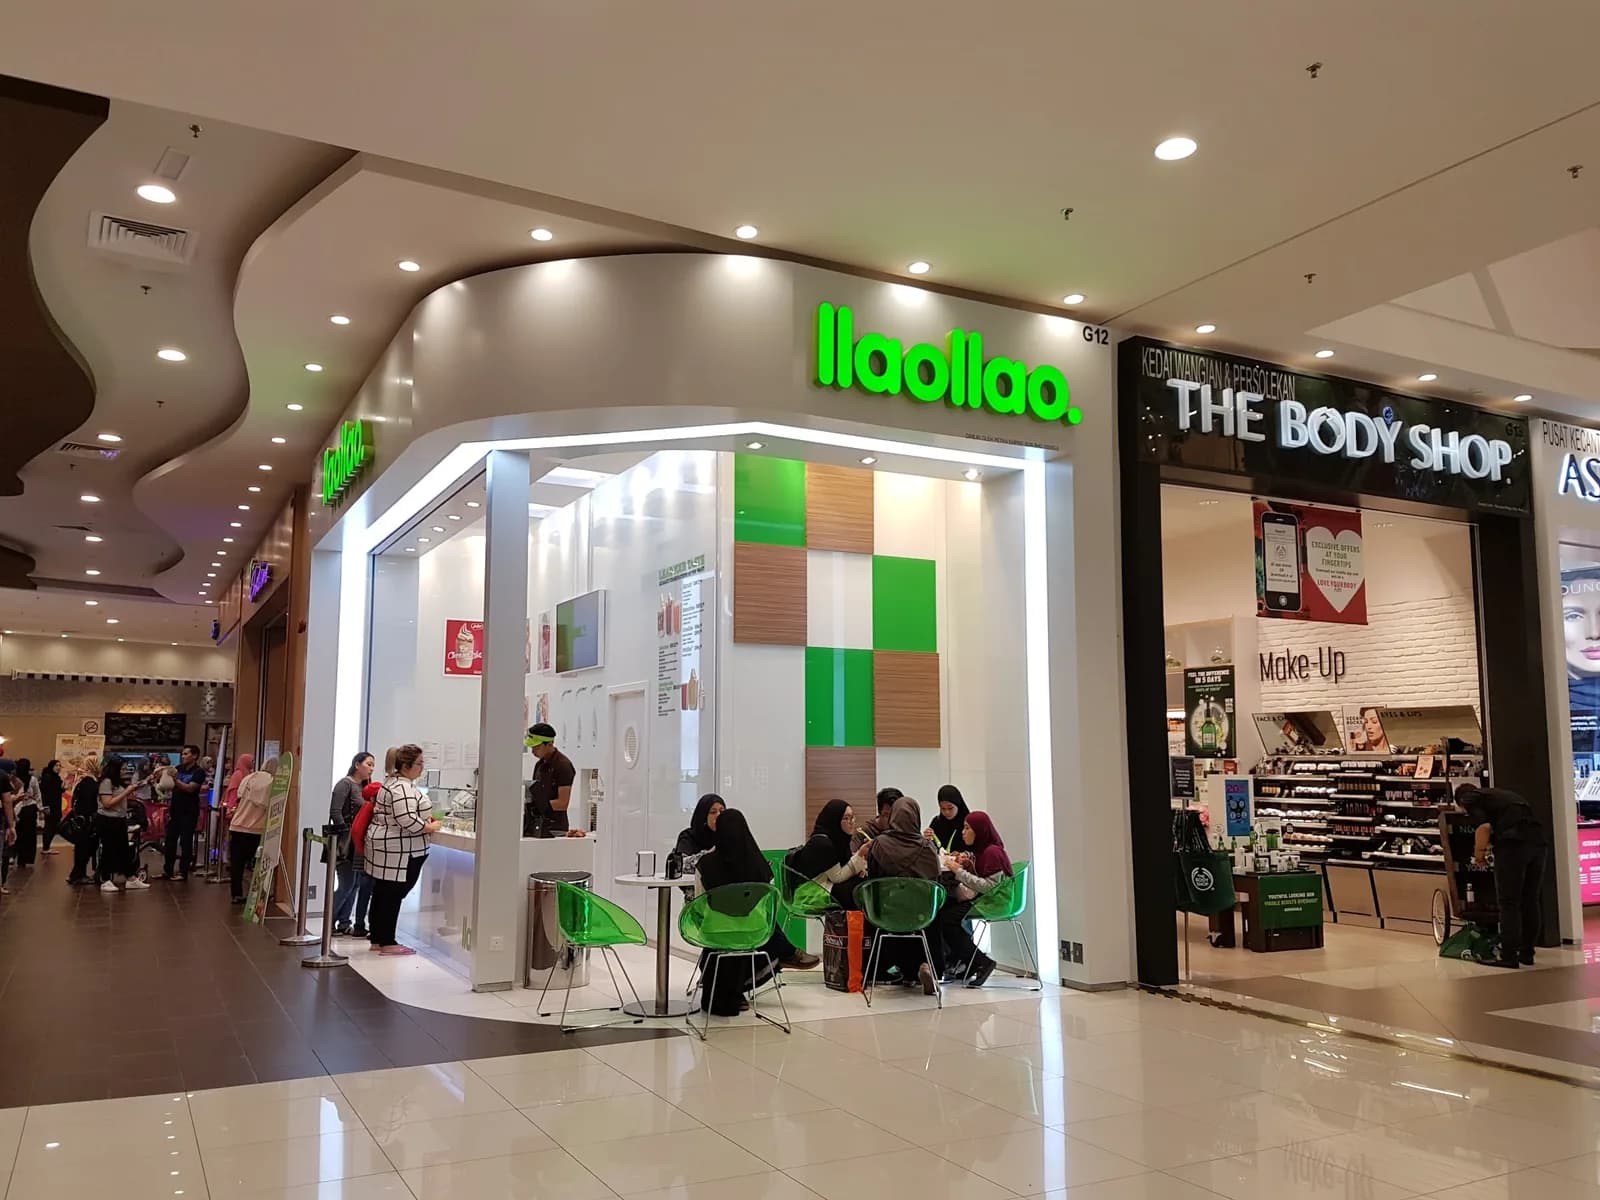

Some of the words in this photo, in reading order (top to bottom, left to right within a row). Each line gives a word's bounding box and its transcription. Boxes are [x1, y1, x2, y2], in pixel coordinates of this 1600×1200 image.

[1083, 325, 1109, 345] G12
[1142, 347, 1173, 379] KEDAI
[1174, 351, 1222, 390] WANGIAN
[1224, 362, 1232, 389] &
[1234, 364, 1296, 401] PERSOLEKAN
[1166, 378, 1266, 442] THE
[1280, 399, 1403, 464] BODY
[1409, 424, 1512, 481] SHOP
[1543, 421, 1569, 449] PUSAT
[1311, 541, 1339, 551] EXCLUSIVE
[1340, 544, 1360, 553] OFFERS
[1321, 558, 1352, 568] FINGERTIPS
[1260, 646, 1345, 684] Make-Up
[1207, 675, 1221, 683] DAYS
